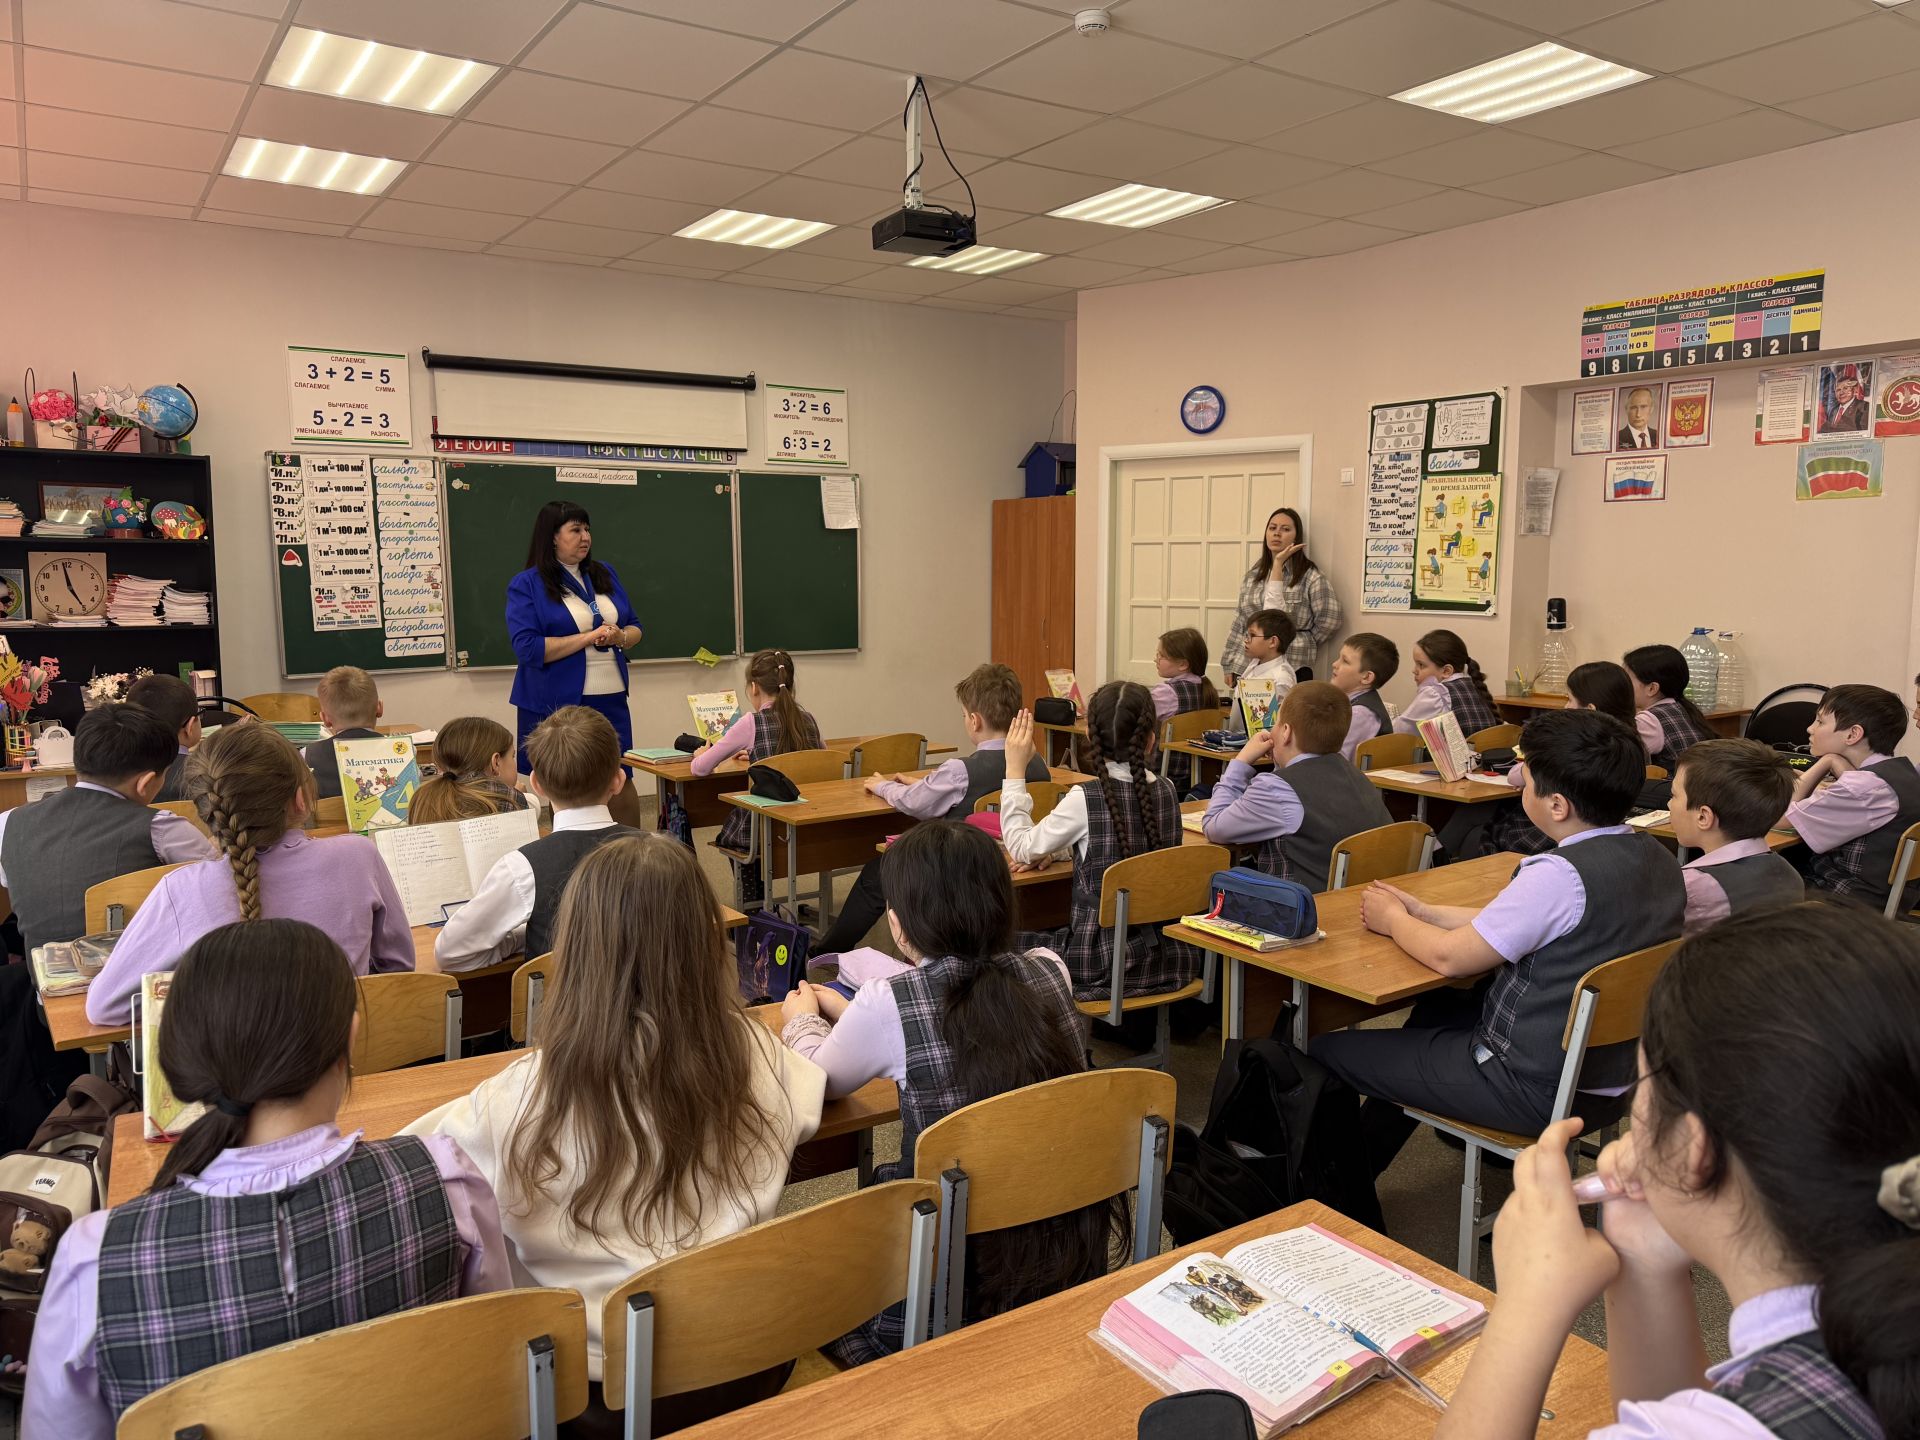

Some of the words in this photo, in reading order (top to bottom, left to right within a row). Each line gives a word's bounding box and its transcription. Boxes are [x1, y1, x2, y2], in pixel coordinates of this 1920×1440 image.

[1624, 296, 1665, 309] ТАБЛИЦА
[1668, 287, 1717, 301] РАЗРЯДОВ
[1730, 278, 1774, 292] КЛАССОВ
[1772, 287, 1791, 295] КЛАСС
[1792, 283, 1817, 292] ЕДИНИЦ
[1688, 299, 1706, 307] КЛАСС
[1707, 297, 1726, 305] ТЫСЯЧ
[330, 356, 366, 364] СЛАГАЕМОЕ
[1588, 361, 1597, 376] 9
[1612, 359, 1620, 372] 8
[1636, 356, 1644, 370] 7
[1663, 352, 1671, 367] 6
[1687, 349, 1696, 364] 5
[1715, 346, 1724, 360] 4
[1742, 342, 1752, 358] 3
[1770, 339, 1779, 354] 2
[1801, 335, 1808, 351] 1
[307, 363, 318, 379] 3
[344, 366, 355, 382] 2
[380, 369, 390, 384] 5
[294, 382, 330, 390] СЛАГАЕМОЕ
[782, 399, 790, 411] 3
[799, 400, 806, 413] 2
[823, 402, 831, 415] 6
[313, 410, 324, 426] 5
[344, 411, 355, 427] 2
[379, 413, 390, 428] 3
[1442, 425, 1448, 435] 5
[783, 437, 791, 449] 6
[799, 437, 807, 450] 3
[823, 439, 831, 451] 2
[643, 447, 655, 458] Ш
[659, 448, 667, 459] С
[672, 449, 681, 459] Х
[686, 450, 695, 461] Ц
[710, 451, 722, 462] Щ
[271, 468, 296, 478] И.п.
[312, 464, 316, 472] 1
[336, 464, 350, 472] 100
[557, 467, 599, 479] Классная
[272, 482, 296, 492] Р.п.
[273, 495, 298, 504] Д.п.
[274, 508, 297, 517] В.п.
[275, 521, 297, 530] Т.п.
[337, 526, 352, 534] 100
[276, 534, 300, 543] П.п.
[345, 757, 404, 767] Математика
